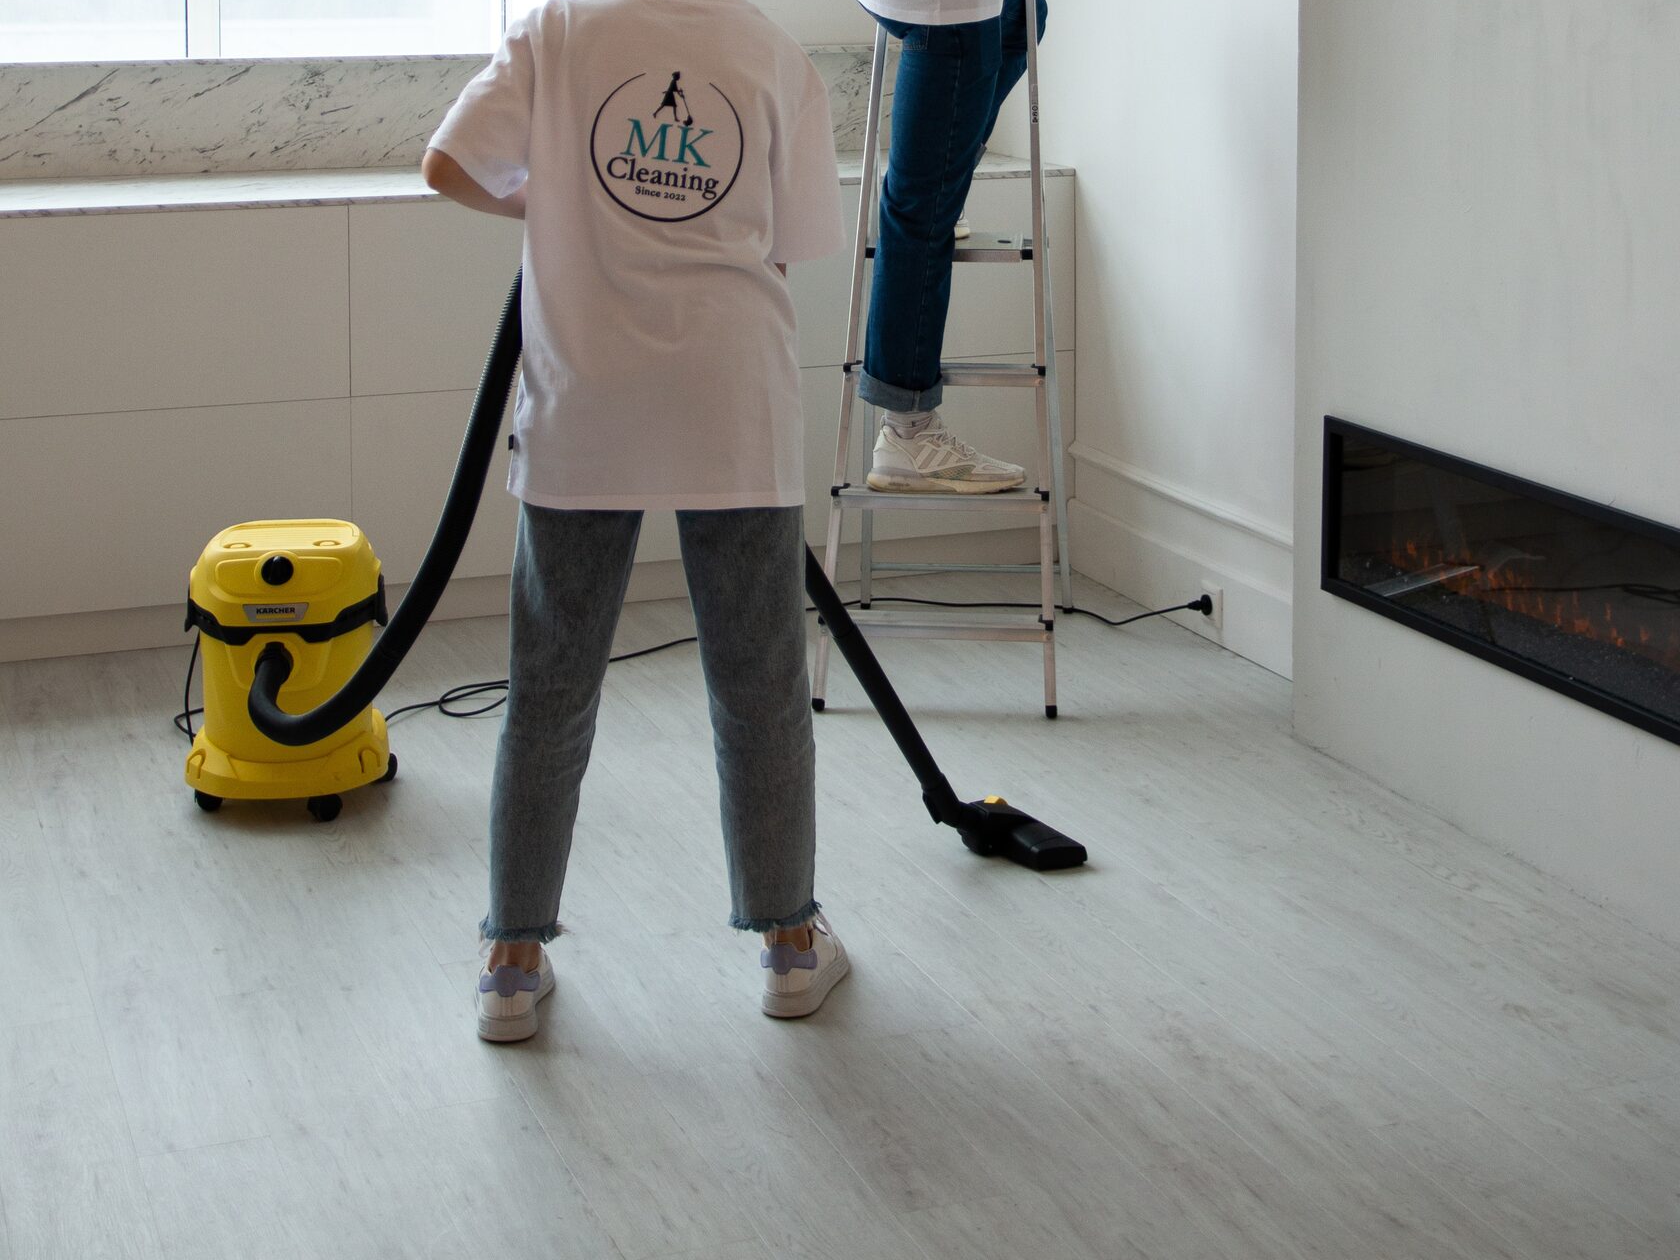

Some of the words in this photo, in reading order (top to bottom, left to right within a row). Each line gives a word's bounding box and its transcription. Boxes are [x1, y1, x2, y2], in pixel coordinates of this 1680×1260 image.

[620, 118, 713, 168] MK
[606, 156, 719, 201] Cleaning
[635, 185, 661, 198] Since
[663, 192, 686, 202] 2022
